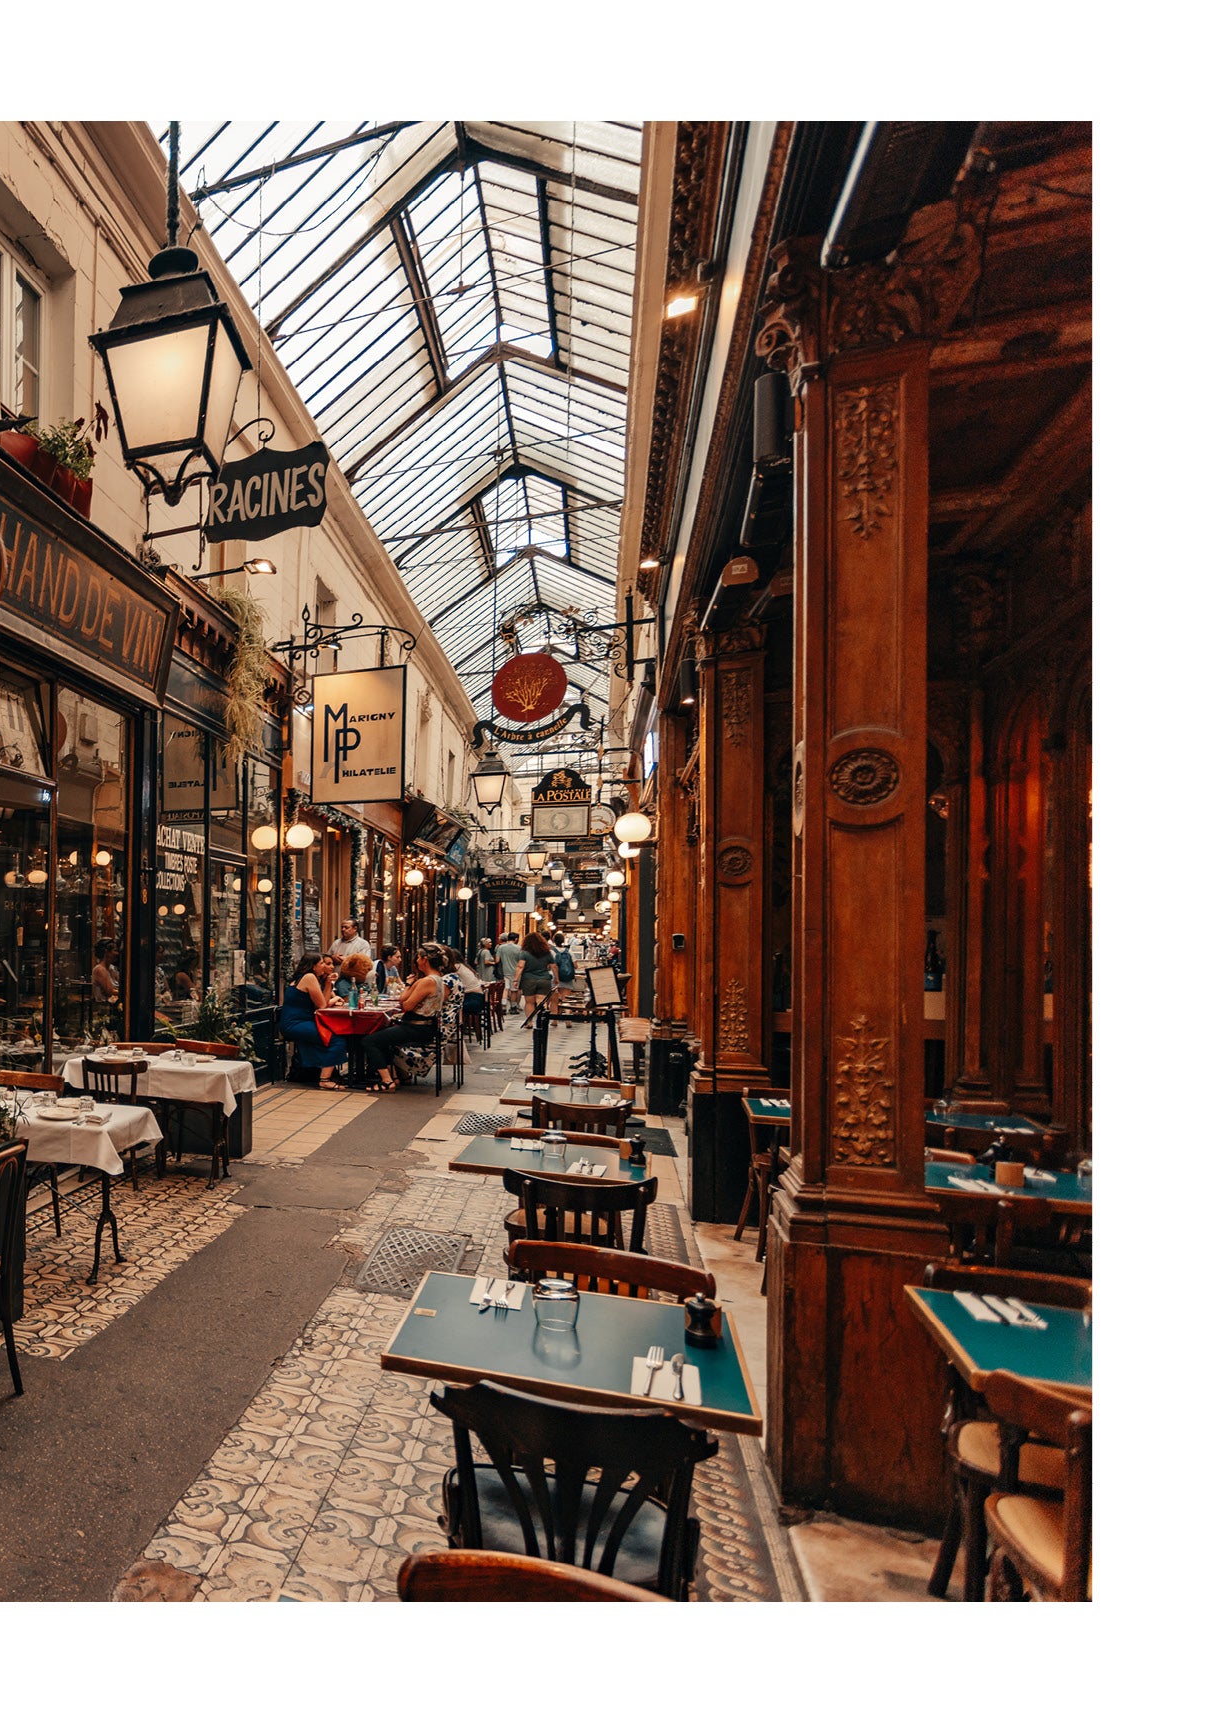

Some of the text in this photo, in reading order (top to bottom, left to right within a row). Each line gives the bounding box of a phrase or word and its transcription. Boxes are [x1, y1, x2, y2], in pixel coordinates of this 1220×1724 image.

[208, 462, 326, 526] RACINES
[80, 574, 121, 649] DE
[121, 600, 162, 674] VIN
[493, 717, 568, 741] L'Arbre à cannelle
[532, 790, 545, 801] LA
[547, 788, 592, 801] POSTALE
[156, 824, 206, 856] ACHAT VENTE
